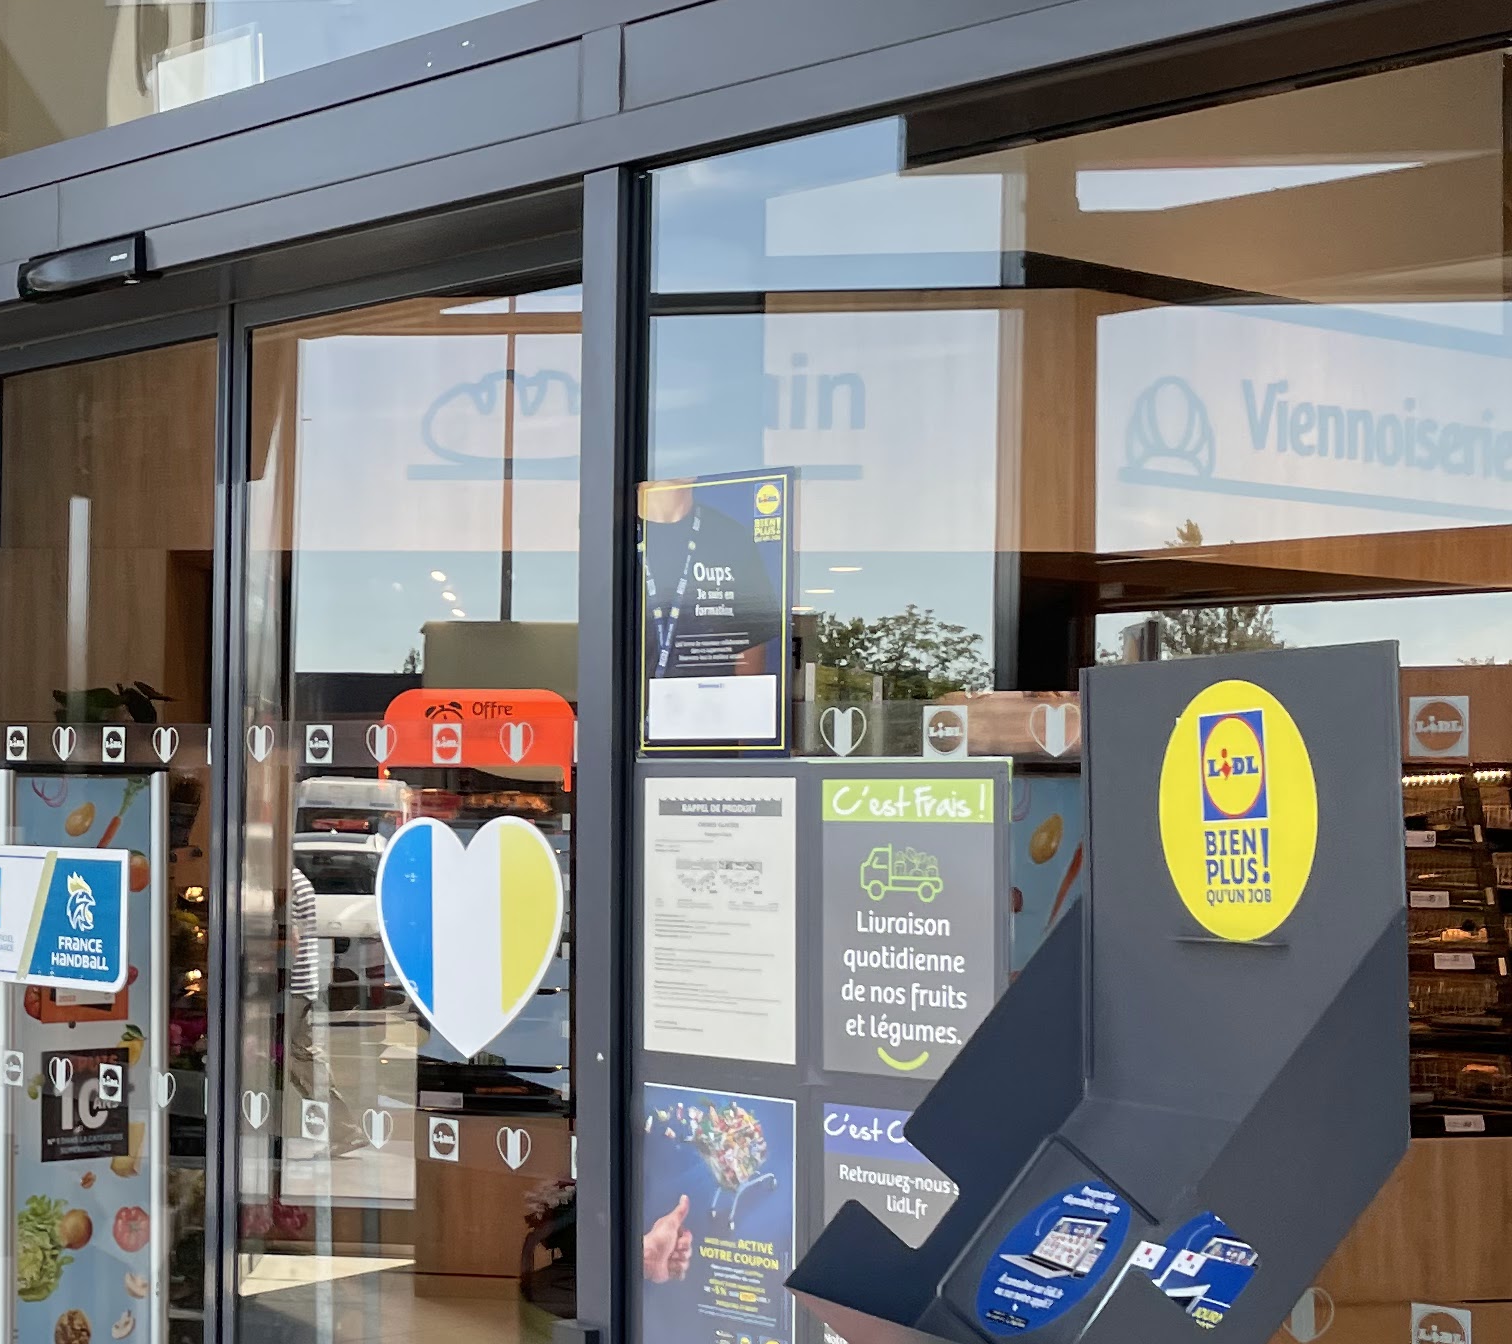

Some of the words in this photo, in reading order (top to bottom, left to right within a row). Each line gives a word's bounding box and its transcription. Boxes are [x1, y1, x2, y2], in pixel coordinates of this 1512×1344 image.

[472, 701, 514, 718] Offre
[914, 786, 972, 818] Frais
[1205, 828, 1257, 856] BIEN
[1206, 858, 1258, 885] PLUS
[1249, 889, 1272, 903] JOB
[856, 910, 951, 938] Livraison
[843, 946, 965, 975] quotidienne
[841, 979, 865, 1003] de
[870, 985, 906, 1005] nos
[910, 981, 967, 1012] fruits
[845, 1017, 866, 1038] et
[870, 1016, 963, 1047] légumes.
[840, 1164, 950, 1194] Retrouvez-nous
[887, 1194, 928, 1219] lidl.fr
[699, 1246, 732, 1263] VOTRE
[734, 1253, 779, 1270] COUPON
